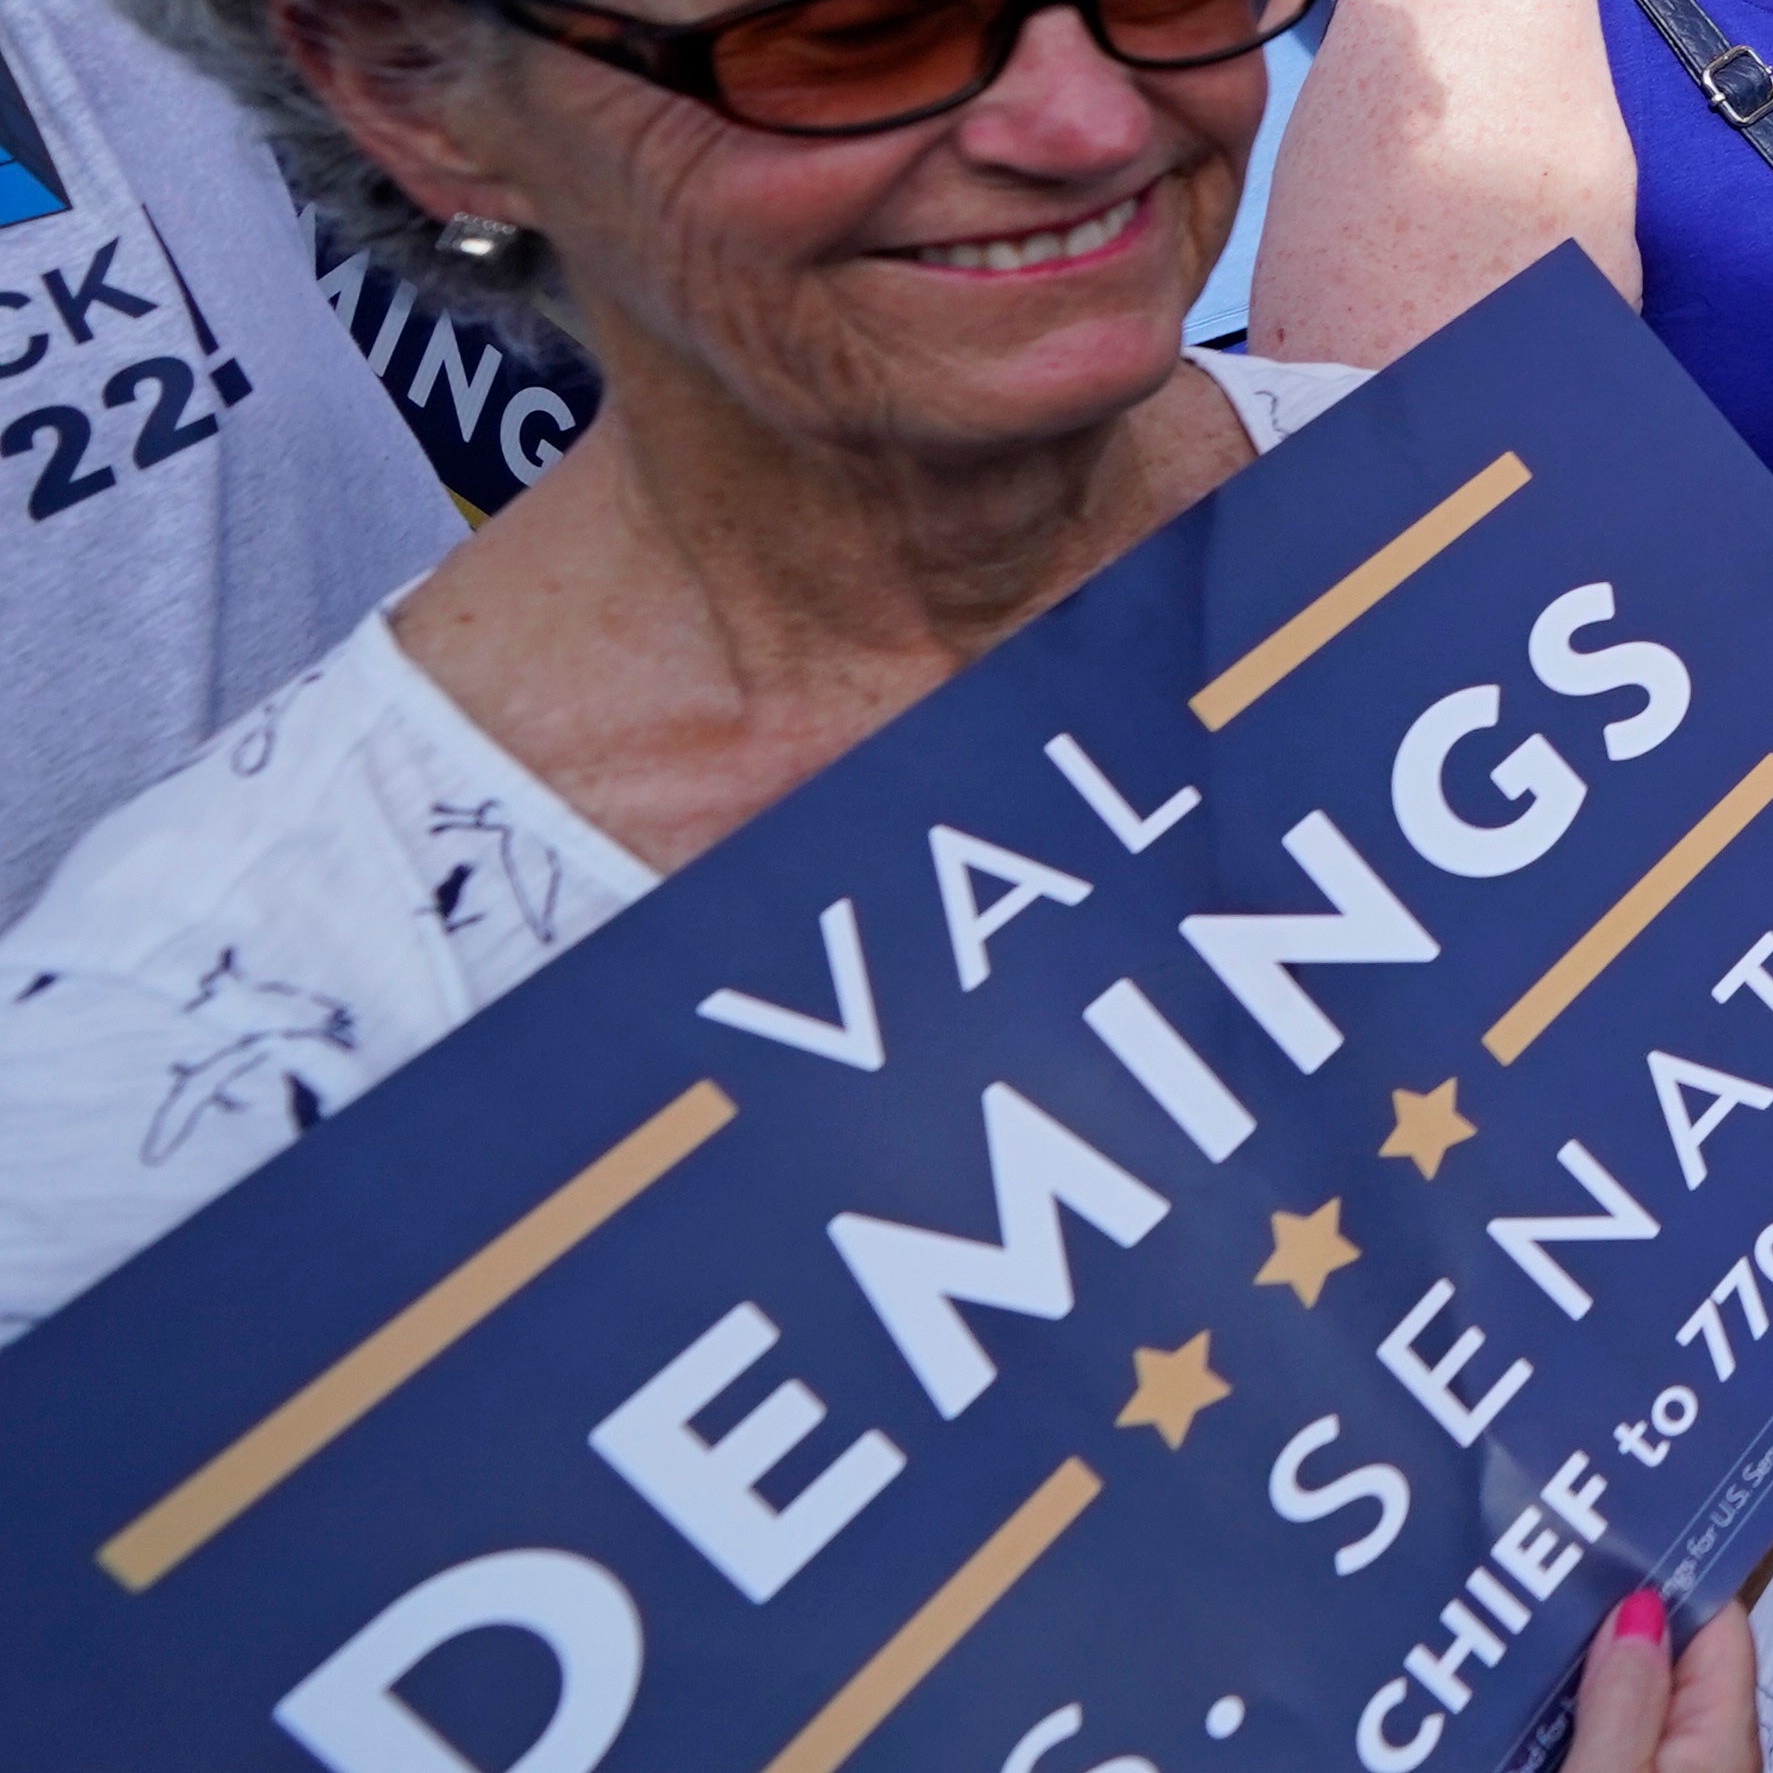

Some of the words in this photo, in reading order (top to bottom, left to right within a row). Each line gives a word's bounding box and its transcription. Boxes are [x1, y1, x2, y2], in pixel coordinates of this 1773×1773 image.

[697, 733, 1200, 1072] VAL
[273, 580, 1693, 1773] DEMINGS
[1357, 1450, 1607, 1773] CHIEF
[1613, 1384, 1698, 1467] to
